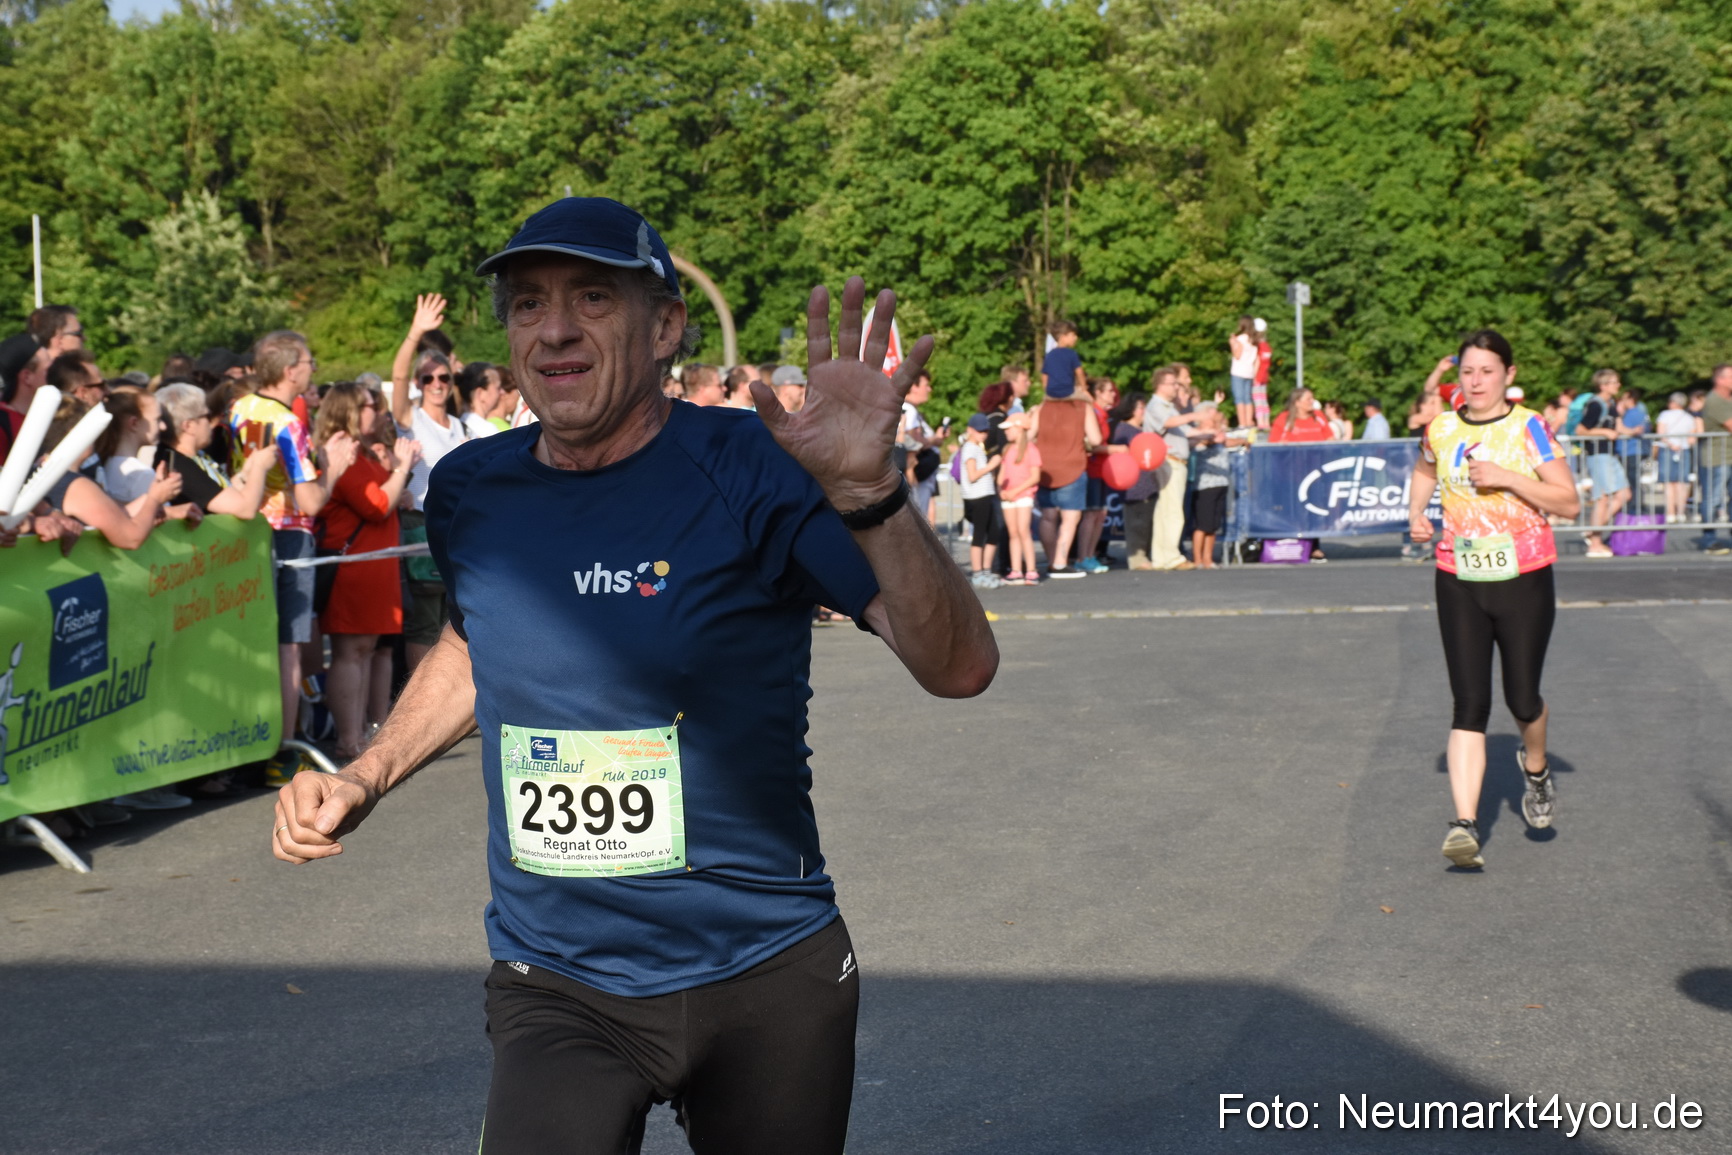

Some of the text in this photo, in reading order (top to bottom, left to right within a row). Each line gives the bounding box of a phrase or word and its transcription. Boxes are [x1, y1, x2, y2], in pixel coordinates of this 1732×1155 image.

[1461, 551, 1507, 569] 1318
[573, 562, 633, 594] vhs
[62, 608, 103, 635] Fischer
[18, 640, 156, 750] firmenlauf
[603, 736, 665, 747] Gesunde Firmen
[16, 730, 79, 774] neumarkt
[521, 755, 585, 773] firmenlauf
[602, 767, 667, 782] run 2019
[519, 781, 654, 836] 2399
[515, 845, 674, 861] Volkshochschule Landkreis Neumarkt/Opf. e.V.
[543, 837, 627, 853] Regnat Otto
